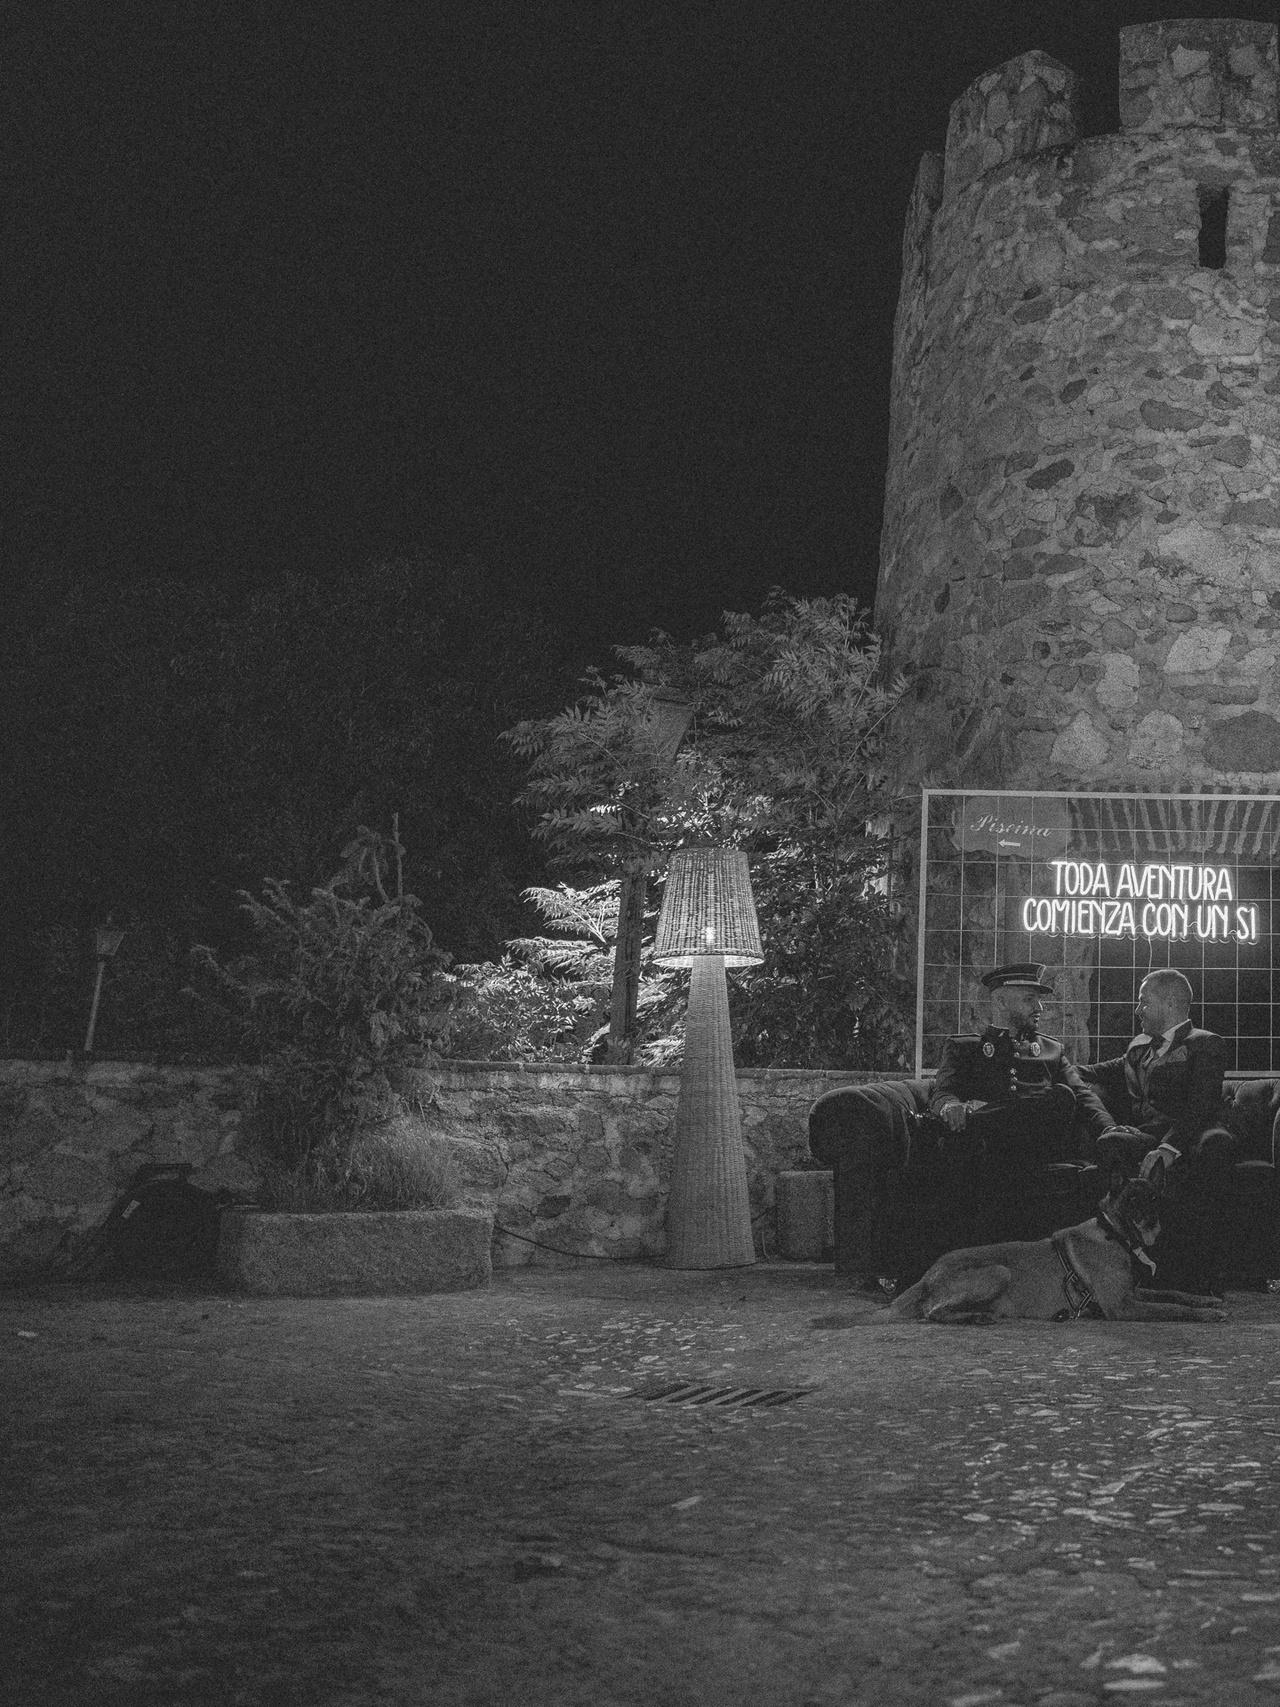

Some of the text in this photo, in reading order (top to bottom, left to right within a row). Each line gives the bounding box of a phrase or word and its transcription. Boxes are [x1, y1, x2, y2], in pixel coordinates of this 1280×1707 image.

[970, 813, 1054, 837] Piscina
[1051, 861, 1233, 901] TODA AVENTURA
[1023, 897, 1136, 936] COMIENZA
[1142, 902, 1189, 938] CON
[1197, 904, 1229, 939] UN
